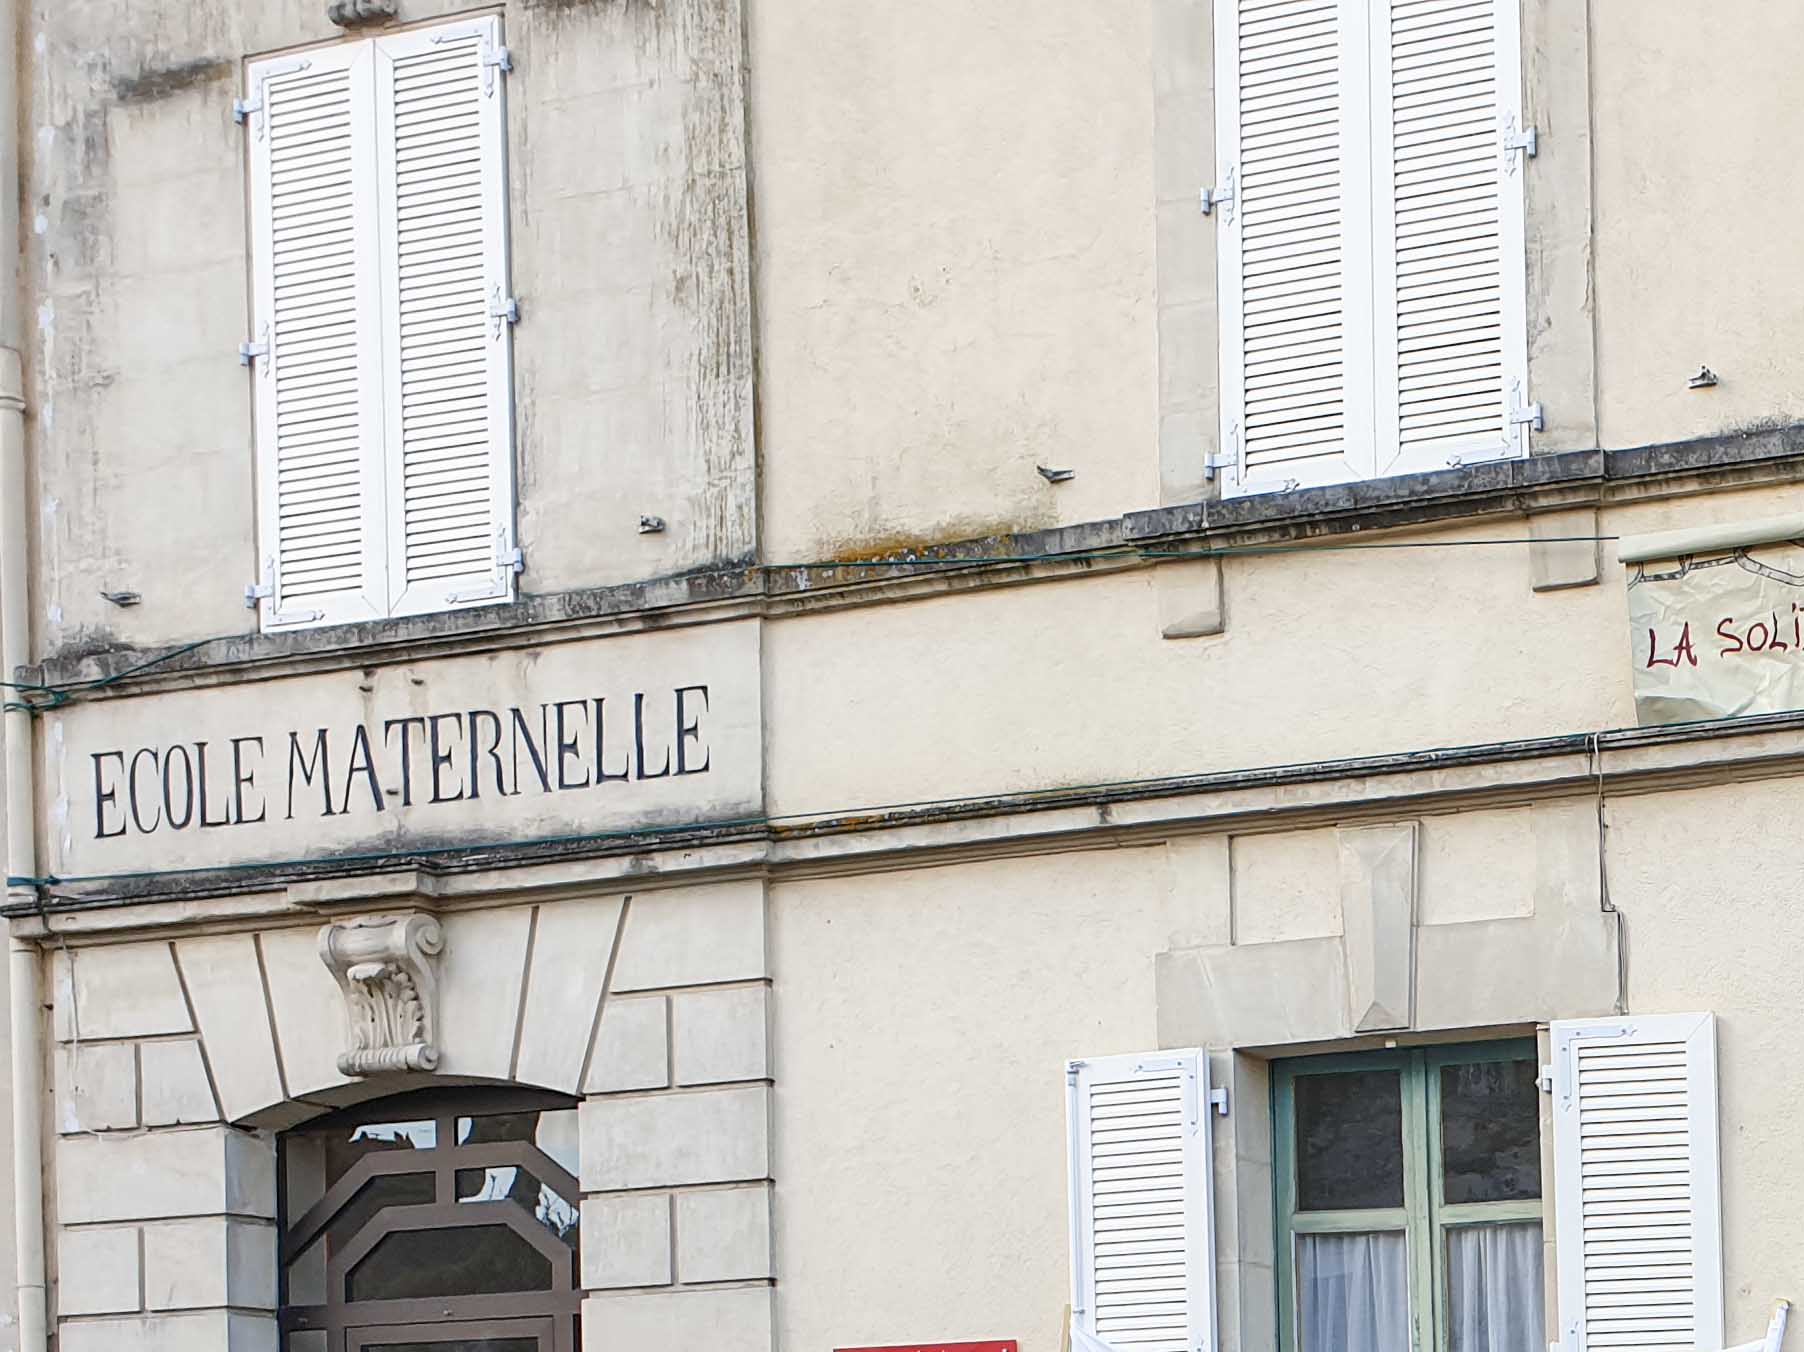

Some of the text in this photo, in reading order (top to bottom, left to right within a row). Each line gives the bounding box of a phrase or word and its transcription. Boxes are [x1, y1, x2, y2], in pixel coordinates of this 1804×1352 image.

[1647, 622, 1698, 671] LA
[91, 685, 711, 839] ECOLE MATERNELLE
